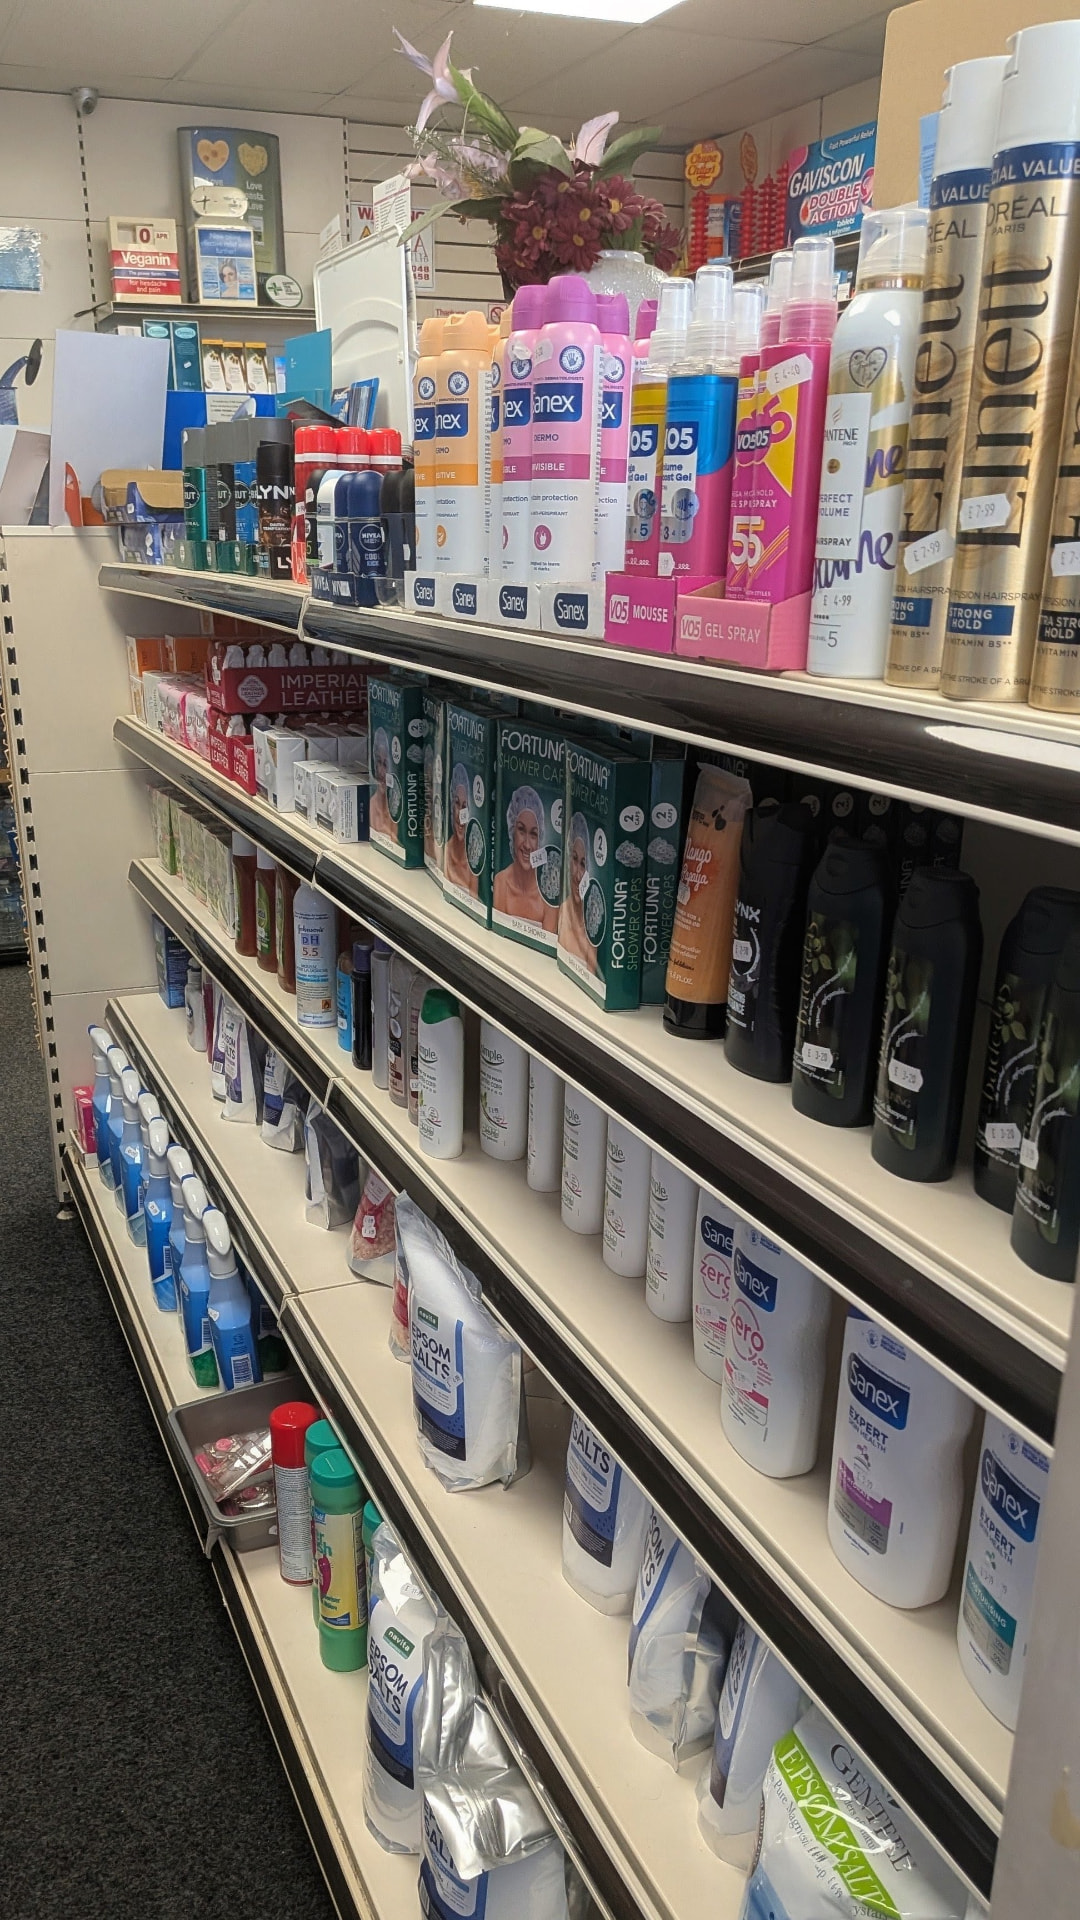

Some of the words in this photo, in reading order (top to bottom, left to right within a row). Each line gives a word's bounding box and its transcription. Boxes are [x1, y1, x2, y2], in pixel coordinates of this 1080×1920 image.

[789, 153, 865, 198] GAVISCON
[810, 181, 862, 210] DOUBLE
[941, 183, 990, 203] VALUE
[810, 200, 859, 225] ACTION
[992, 223, 1025, 236] PARIS
[121, 252, 171, 267] Veganin
[139, 279, 167, 288] headache
[533, 394, 575, 414] anex
[635, 473, 648, 481] Gel
[676, 473, 692, 481] Gel
[541, 495, 578, 504] protection
[640, 523, 648, 537] 5
[664, 526, 669, 540] 3
[415, 582, 434, 601] Sanex
[455, 588, 475, 608] Sanex
[501, 590, 525, 613] Sanex
[557, 598, 586, 622] Sanex
[610, 598, 628, 620] VO5
[633, 604, 668, 623] MOUSSE
[949, 608, 993, 620] STRONG
[682, 619, 701, 639] VO5
[705, 623, 724, 639] GEL
[728, 625, 761, 644] SPRAY
[952, 619, 982, 630] HOLD
[1044, 628, 1075, 640] HOLD
[828, 631, 838, 648] 5
[281, 673, 368, 689] IMPERIAL
[958, 676, 987, 685] STROKE
[990, 677, 1002, 685] OF
[281, 690, 369, 706] LEATHER
[369, 684, 400, 707] FORTUNA
[448, 710, 485, 743] FORTUNA
[210, 734, 227, 751] IMPERIAL
[211, 750, 229, 769] LEATHER
[234, 745, 248, 768] IMPERIAL
[499, 752, 540, 777] SHOWER
[234, 761, 249, 782] LEATHER
[566, 749, 611, 790] FORTUNA
[407, 770, 418, 838] FORTUNA
[657, 811, 667, 820] 2
[624, 814, 634, 822] 2
[597, 836, 603, 850] 2
[630, 878, 642, 913] CAPS
[662, 874, 675, 910] CAPS
[611, 878, 628, 970] FORTUNA
[644, 873, 660, 963] FORTUNA
[301, 935, 319, 946] pH
[527, 926, 547, 940] SHOWER
[627, 916, 640, 970] SHOWER
[302, 947, 319, 957] 5.5
[704, 1220, 734, 1250] Sane
[734, 1257, 771, 1302] Sanex
[731, 1306, 764, 1353] zero
[412, 1321, 451, 1363] EPSOM
[412, 1340, 450, 1380] SALTS
[850, 1361, 899, 1418] Sanex
[849, 1405, 888, 1443] EXPERT
[848, 1418, 860, 1434] SKIN
[860, 1429, 886, 1454] HEALTH
[572, 1423, 611, 1474] SALTS
[982, 1465, 1028, 1530] Sanex
[979, 1505, 1016, 1556] EXPERT
[388, 1630, 411, 1652] navita
[370, 1636, 409, 1698] EPSOM
[369, 1657, 402, 1715] SALTS
[774, 1779, 788, 1805] Pure
[779, 1744, 848, 1857] EPSOM
[837, 1848, 888, 1909] SALT
